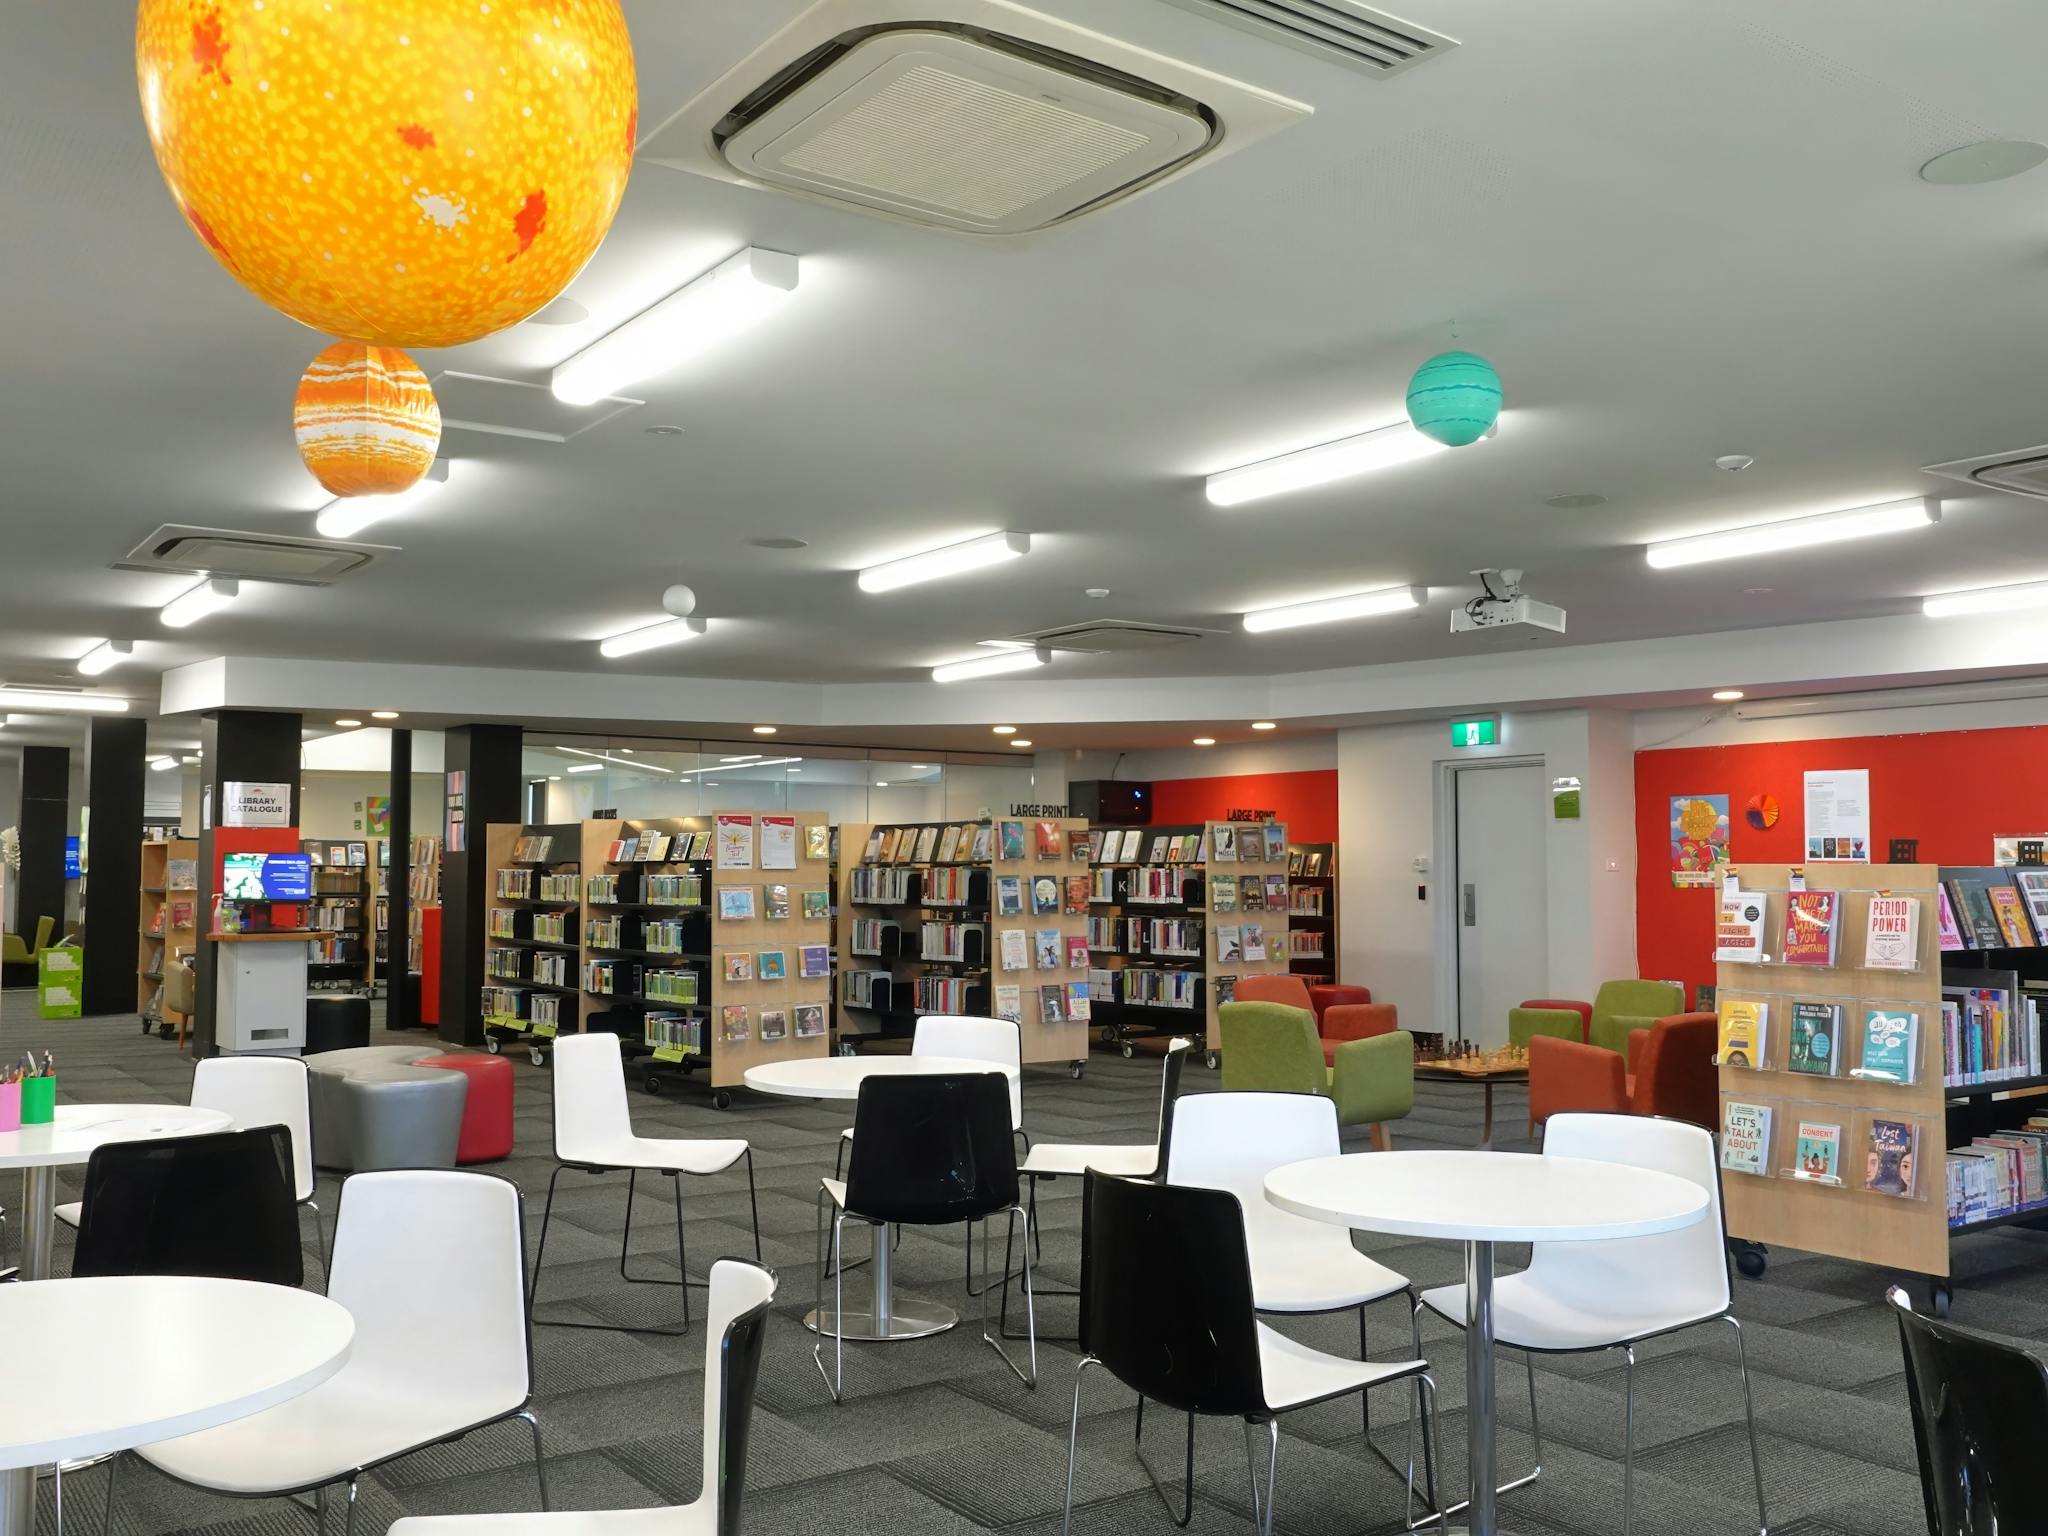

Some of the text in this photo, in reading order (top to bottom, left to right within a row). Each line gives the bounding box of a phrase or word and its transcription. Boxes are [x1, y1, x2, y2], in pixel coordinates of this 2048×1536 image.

[238, 797, 276, 805] LIBRARY
[231, 805, 283, 813] CATALOGUE
[1010, 803, 1069, 818] LARGE PRINT
[1227, 808, 1253, 822] LARGE
[1118, 880, 1127, 892] K
[1799, 894, 1822, 908] NOT
[1873, 901, 1907, 916] PERIOD
[1872, 917, 1906, 932] POWER
[1142, 931, 1149, 943] L
[1799, 932, 1817, 944] YOU
[1731, 1116, 1756, 1128] LET'S
[1731, 1127, 1754, 1139] TALK
[1802, 1127, 1834, 1138] CONSENT
[1881, 1125, 1900, 1140] Lost
[1727, 1138, 1758, 1151] ABOUT
[1874, 1139, 1907, 1153] Taiwan
